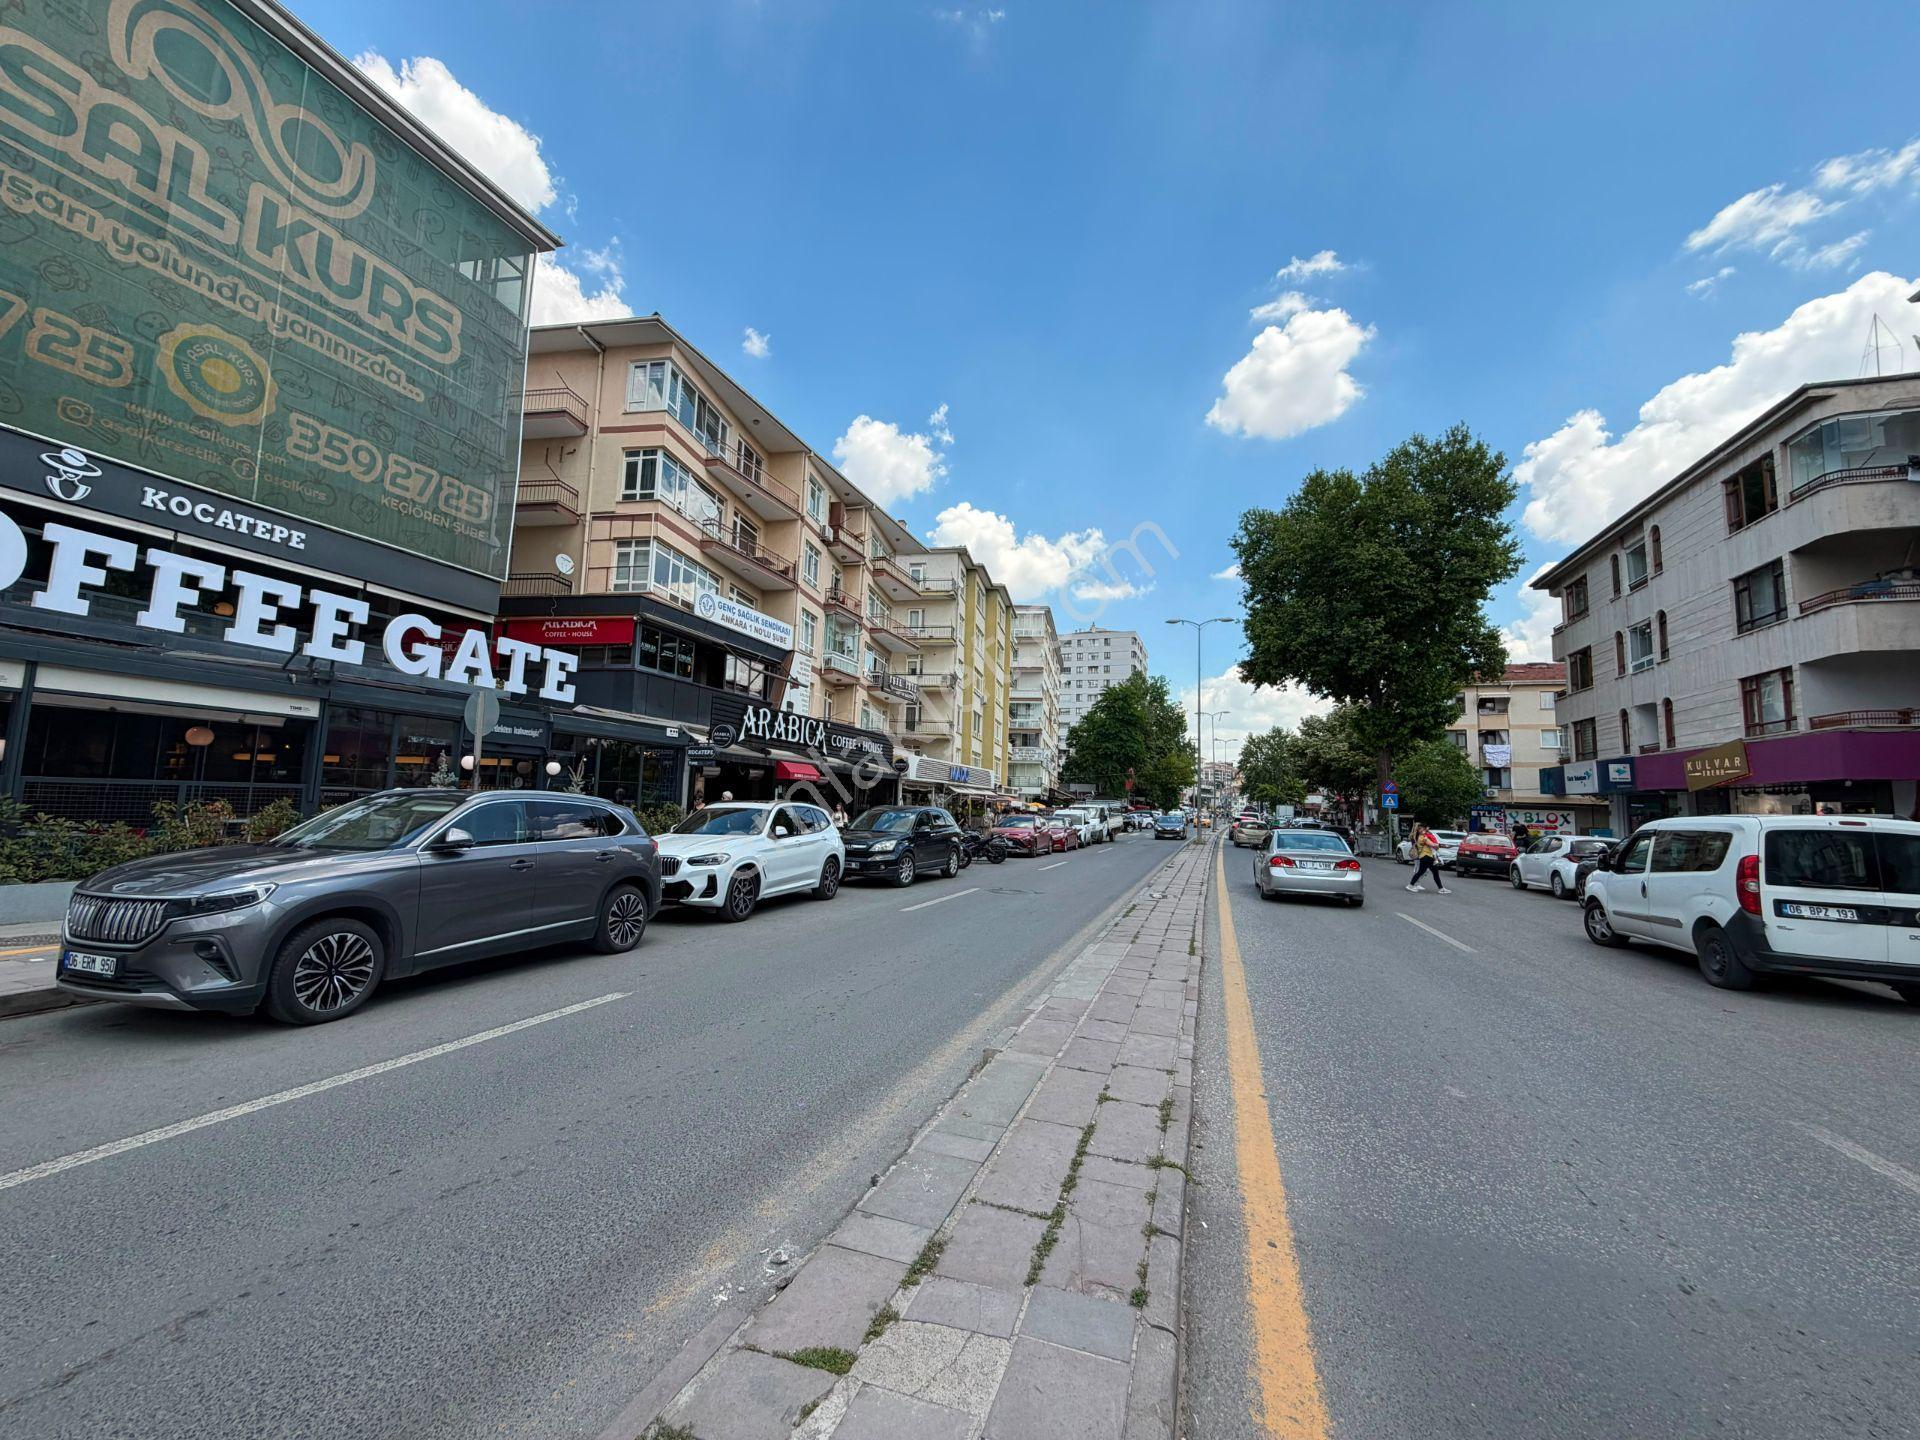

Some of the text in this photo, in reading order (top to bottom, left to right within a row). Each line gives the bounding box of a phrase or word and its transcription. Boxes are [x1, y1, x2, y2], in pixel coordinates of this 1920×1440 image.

[0, 170, 97, 234] şarı
[110, 225, 260, 313] yolunda
[250, 190, 459, 358] KURS
[31, 312, 130, 384] 25
[186, 342, 224, 361] ASAL
[226, 351, 257, 387] KURS
[289, 413, 380, 480] 859
[386, 456, 438, 502] 27
[141, 486, 306, 550] KOCATEPE
[717, 601, 736, 617] GENÇ
[737, 608, 761, 624] SAĞLIK
[761, 618, 791, 636] SENDİKASI
[720, 613, 748, 631] ANKARA
[382, 613, 578, 703] GATE
[738, 704, 884, 755] ARABICA COFFEE HOUSE
[1687, 757, 1741, 771] KULVAR
[1524, 812, 1571, 827] BLOX
[1789, 904, 1856, 919] 06 BPZ 193
[69, 954, 78, 968] 06
[100, 958, 115, 973] 950
